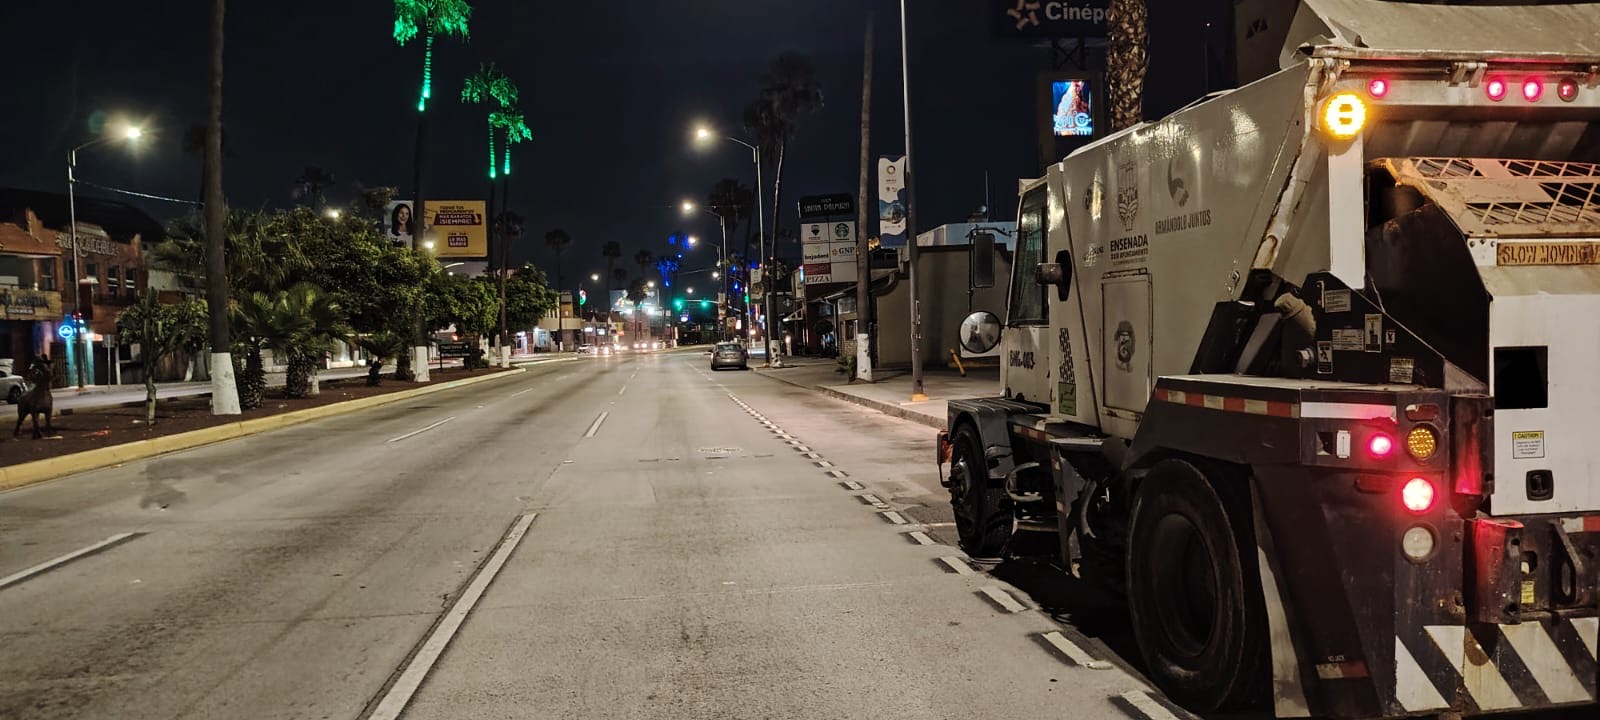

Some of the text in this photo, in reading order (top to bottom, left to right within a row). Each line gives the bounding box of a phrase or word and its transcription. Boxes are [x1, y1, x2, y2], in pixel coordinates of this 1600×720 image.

[1188, 209, 1211, 228] JUNTOS
[838, 247, 855, 255] GNP
[1110, 234, 1148, 252] ENSENADA
[1502, 245, 1537, 264] SLOW
